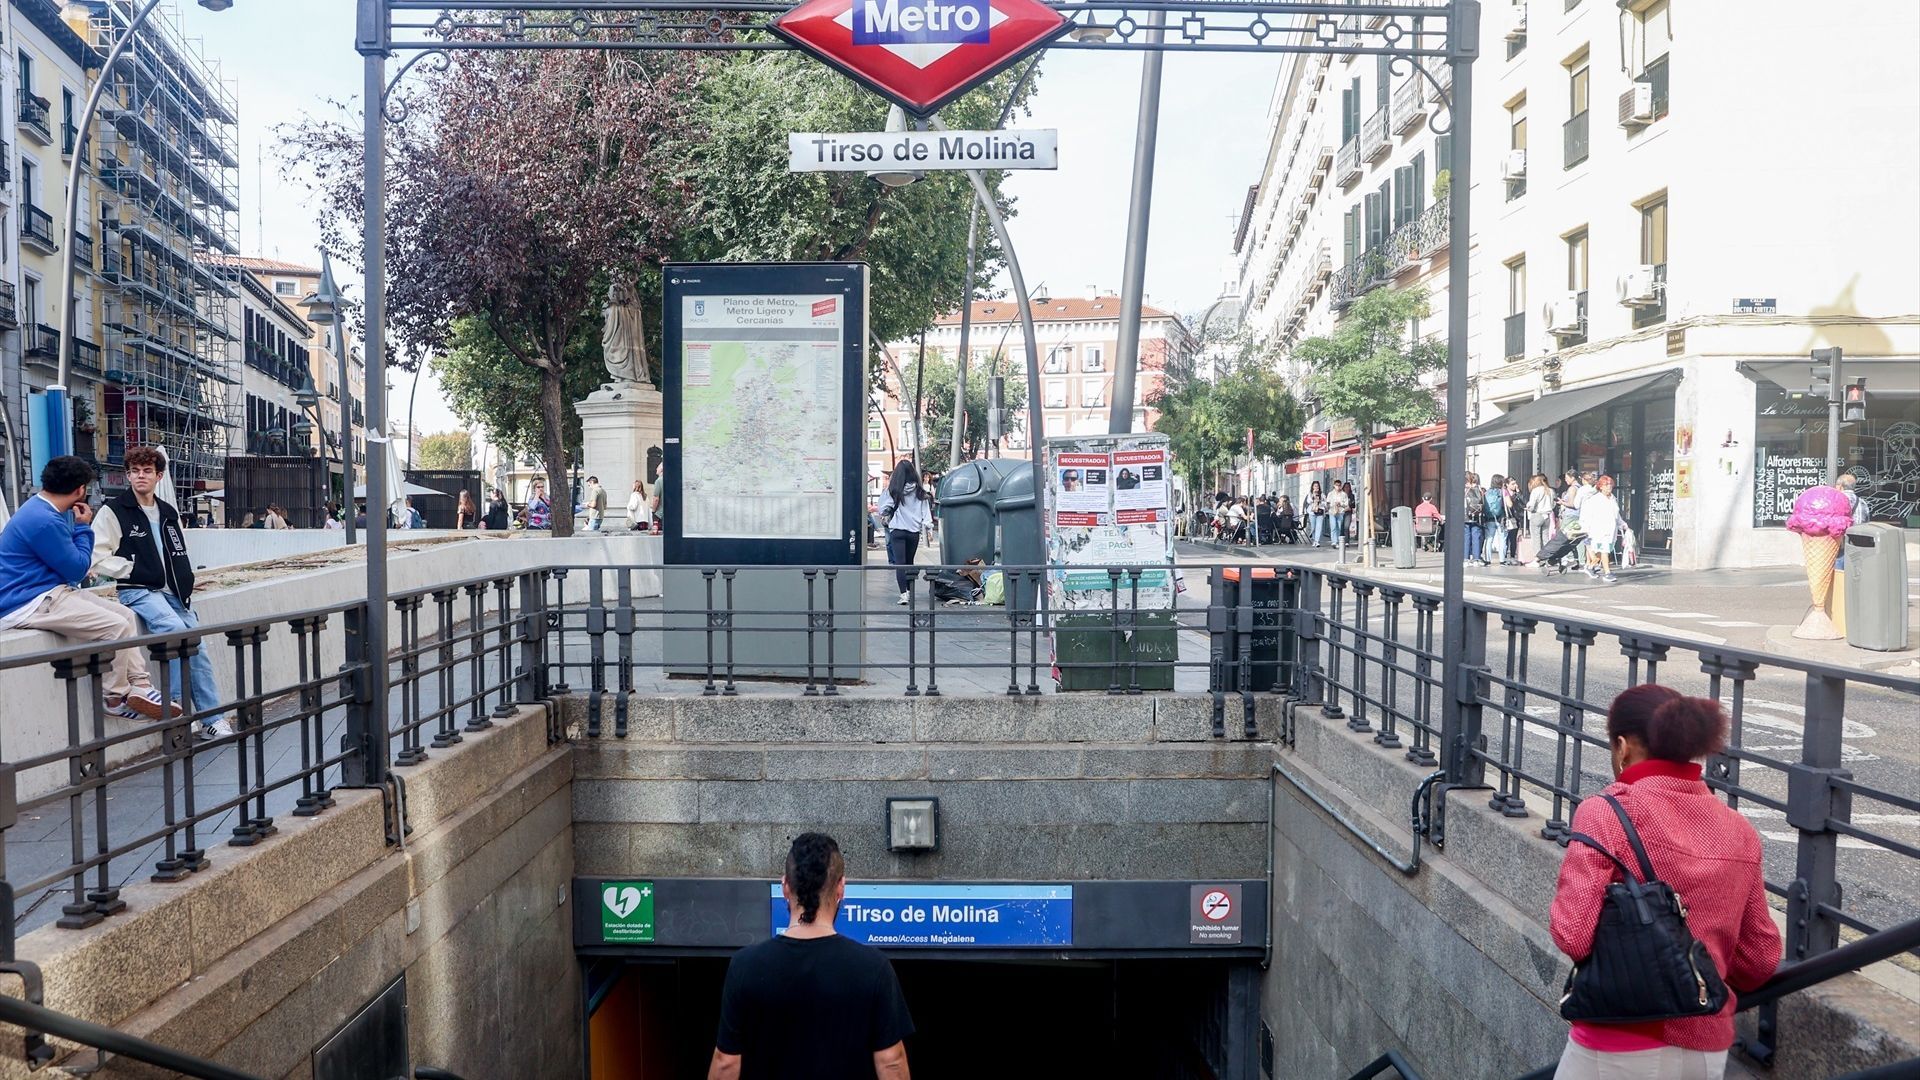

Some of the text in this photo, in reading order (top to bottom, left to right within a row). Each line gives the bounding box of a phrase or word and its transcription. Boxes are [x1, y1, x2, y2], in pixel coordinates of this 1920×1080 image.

[864, 0, 981, 33] Metro
[811, 136, 1036, 163] Tirso de Molina
[723, 297, 750, 306] Plano
[752, 297, 764, 306] de
[726, 306, 795, 317] Metro Ligero y
[1766, 455, 1801, 469] Alfajores
[1802, 458, 1824, 467] FRESH
[1777, 473, 1818, 486] Pastries
[1756, 467, 1766, 514] SNACKS
[843, 904, 999, 923] Tirso de Molina
[867, 934, 975, 944] Acceso/Access Magdalena
